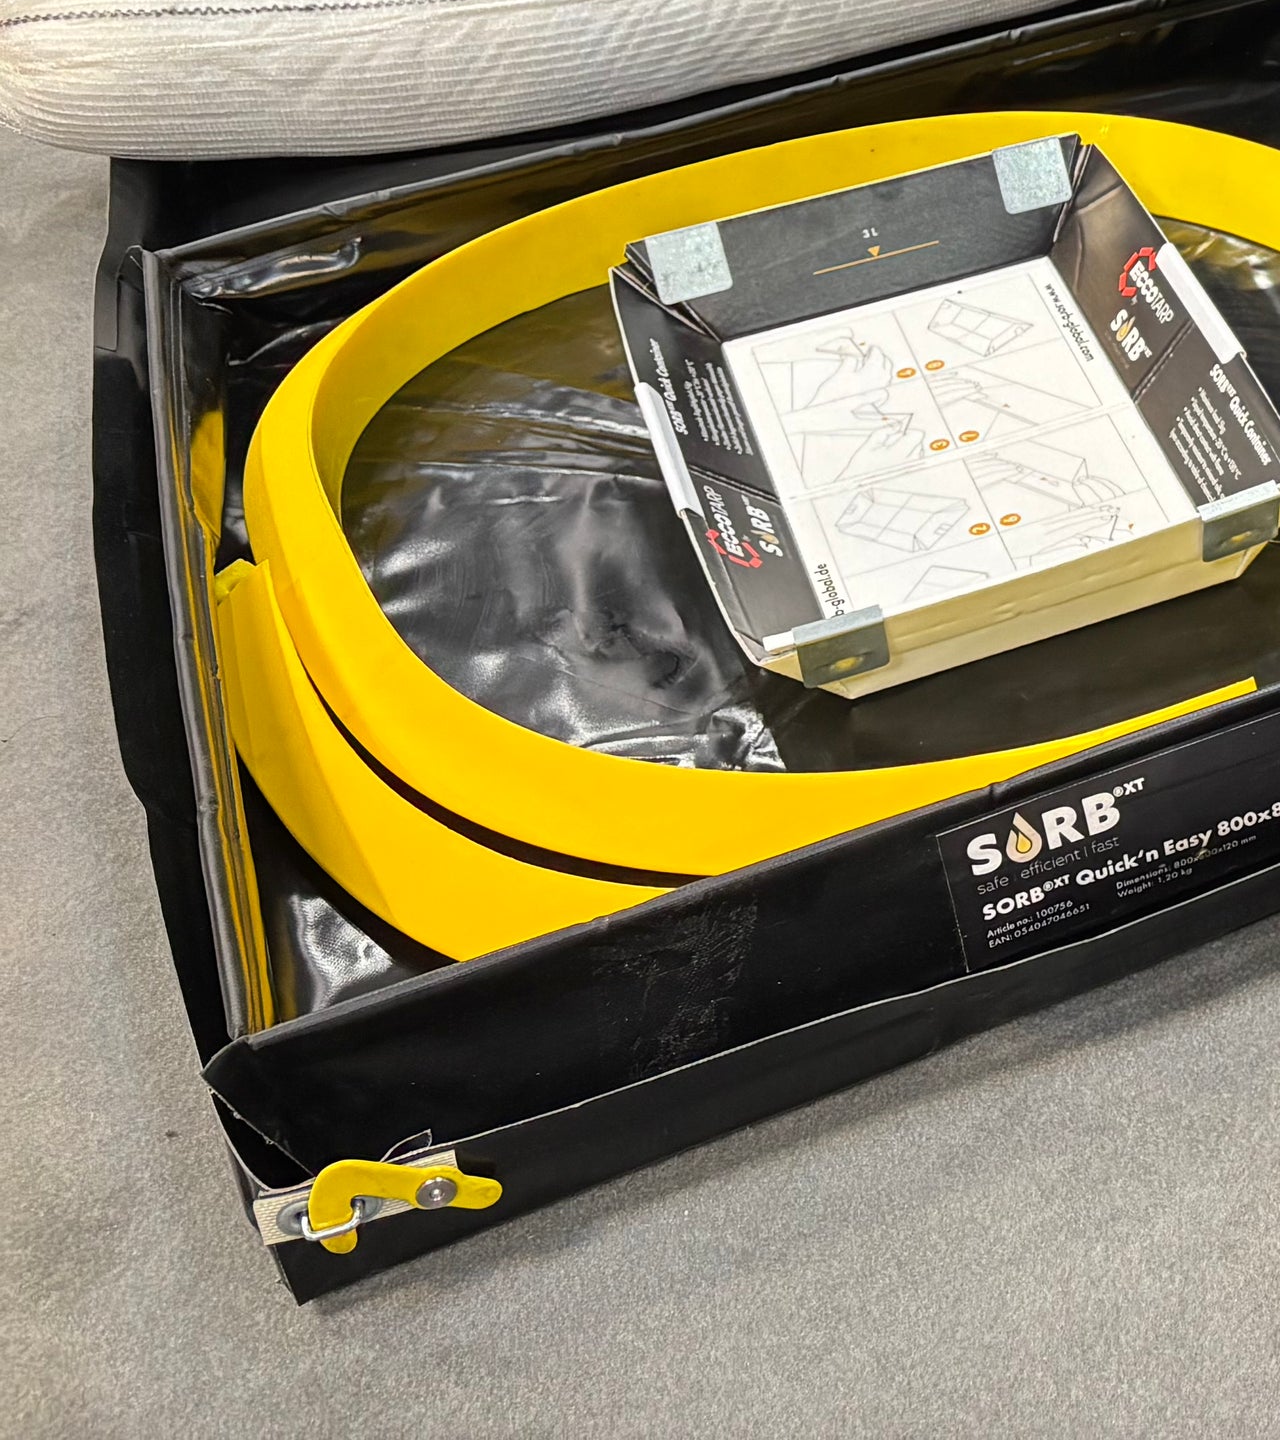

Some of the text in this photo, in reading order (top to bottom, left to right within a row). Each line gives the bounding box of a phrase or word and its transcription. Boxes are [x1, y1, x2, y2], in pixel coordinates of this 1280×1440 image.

[1128, 260, 1175, 325] ECCOTARP
[1246, 420, 1272, 467] Container
[703, 484, 745, 558] ECCOTARP
[977, 836, 1121, 896] safe efficient fast
[1115, 865, 1172, 890] Dimensions:
[1240, 834, 1257, 845] mm
[1163, 828, 1214, 857] Easy
[1117, 881, 1155, 899] Weight:
[1180, 866, 1193, 877] kg
[986, 922, 1016, 939] Article
[1035, 899, 1074, 920] 100756
[988, 933, 1013, 949] EAN:
